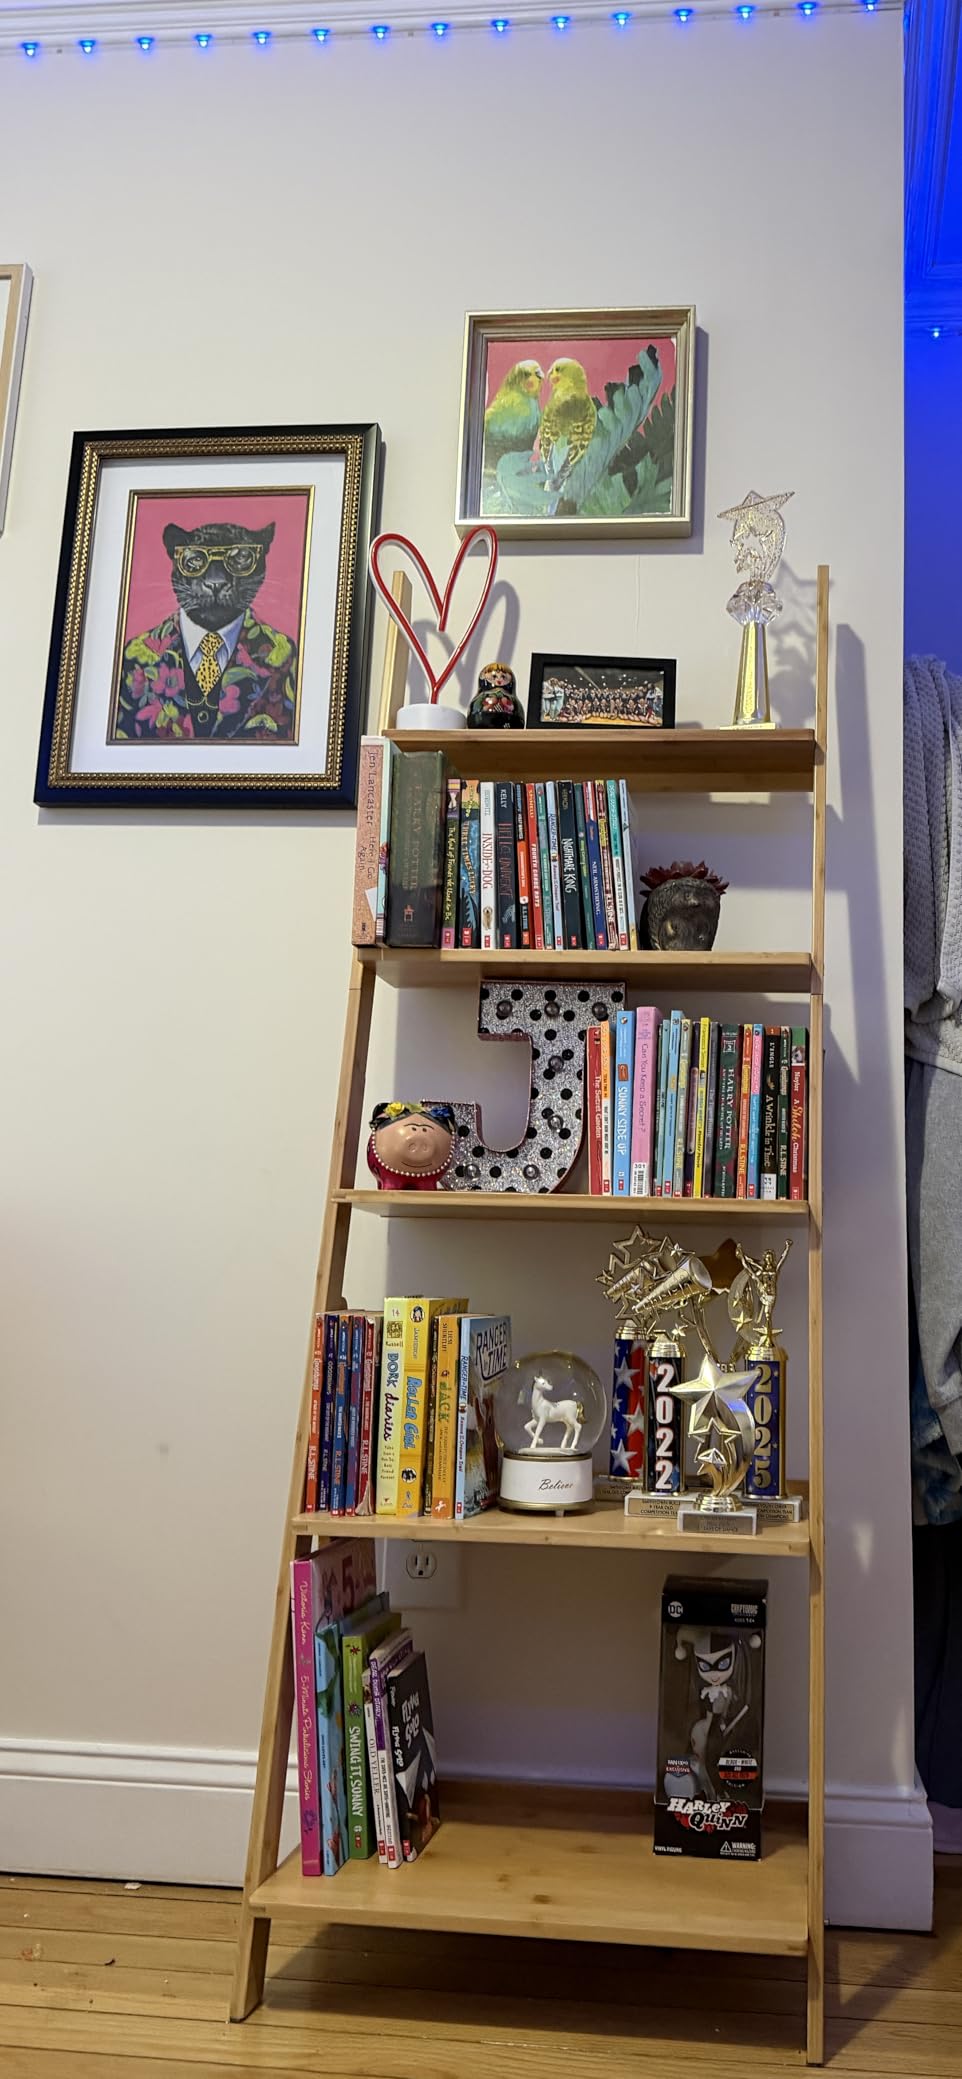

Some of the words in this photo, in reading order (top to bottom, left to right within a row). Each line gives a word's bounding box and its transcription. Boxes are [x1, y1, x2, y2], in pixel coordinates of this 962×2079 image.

[368, 752, 379, 768] Jen
[366, 771, 378, 826] Lancaster
[500, 789, 508, 808] KELLY
[448, 827, 456, 837] The
[461, 821, 471, 846] THREE
[367, 836, 376, 857] Here
[447, 838, 457, 850] Kind
[482, 832, 493, 863] INSIDE
[562, 838, 575, 872] NIGHTMARE
[447, 859, 456, 878] Friends
[463, 847, 474, 871] TIMES
[367, 866, 375, 880] Go
[468, 872, 477, 895] LUCKY
[482, 869, 493, 889] DOG
[565, 873, 577, 893] KING
[641, 1043, 649, 1059] Can
[640, 1059, 648, 1073] You
[593, 1075, 601, 1089] The
[639, 1074, 647, 1092] Keep
[726, 1068, 735, 1108] HARRY
[793, 1071, 801, 1092] Naylor
[594, 1090, 602, 1113] Secret
[617, 1086, 629, 1116] SUNNY
[766, 1094, 774, 1102] A
[594, 1113, 602, 1139] Garden
[616, 1119, 628, 1141] SIDE
[724, 1110, 733, 1150] POTTER
[765, 1102, 776, 1137] Wrinkle
[791, 1104, 803, 1140] Shiloh
[616, 1143, 627, 1156] UP
[765, 1137, 773, 1145] in
[764, 1145, 775, 1168] Time
[780, 1157, 788, 1176] STINE
[392, 1309, 400, 1317] 14
[475, 1321, 507, 1366] RANGER
[386, 1353, 399, 1388] DORK
[461, 1355, 469, 1382] RANGER
[487, 1346, 508, 1376] TIME
[405, 1376, 424, 1420] ROLLER
[438, 1381, 452, 1425] JACK
[459, 1385, 467, 1401] TIME
[384, 1393, 400, 1442] diaries
[655, 1363, 675, 1490] 2022
[753, 1364, 773, 1489] 2025
[403, 1422, 420, 1450] GIRL
[308, 1459, 316, 1480] STINE
[360, 1455, 369, 1475] STINE
[299, 1581, 309, 1619] Victoria
[669, 1603, 683, 1614] DC
[301, 1621, 310, 1645] Kann
[370, 1661, 379, 1678] DEAR
[300, 1675, 311, 1717] 5-Minute
[372, 1679, 380, 1697] DUMB
[302, 1717, 312, 1769] Pinkalicious
[349, 1725, 362, 1765] SWING
[369, 1738, 377, 1759] OLD
[349, 1765, 361, 1779] IT,
[371, 1759, 381, 1795] YELLER
[304, 1769, 313, 1801] Stories
[351, 1779, 363, 1817] SUNNY
